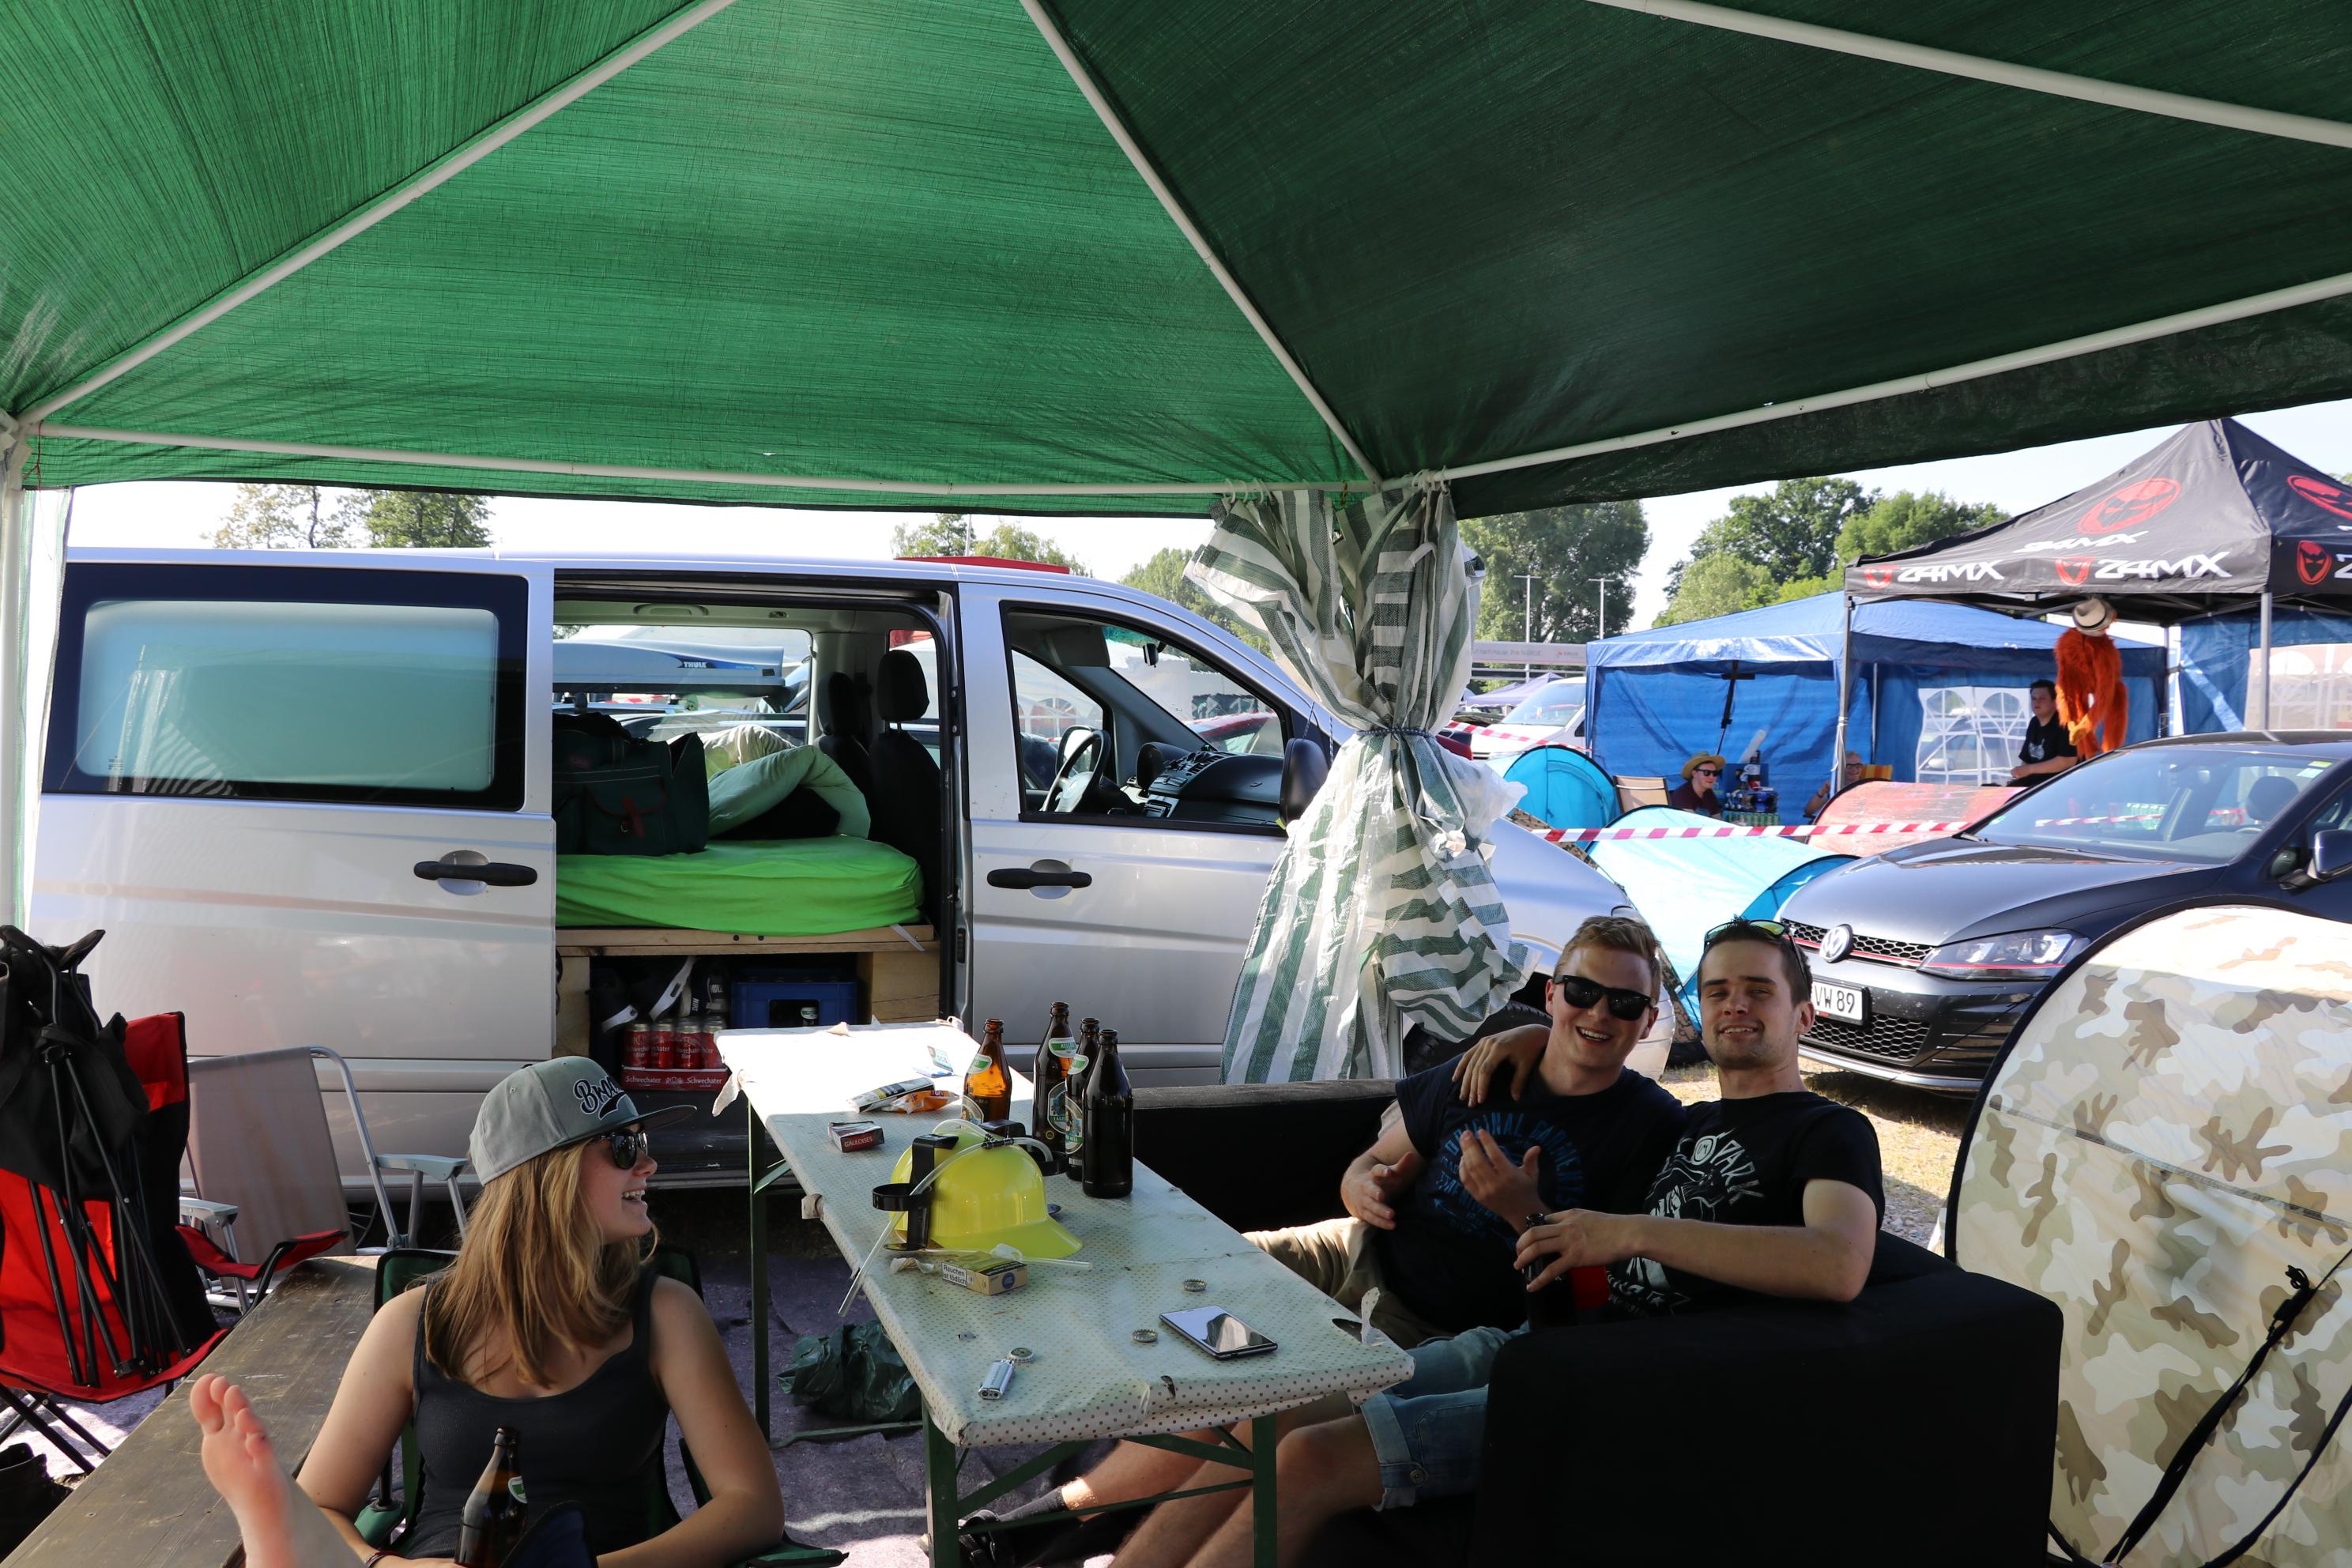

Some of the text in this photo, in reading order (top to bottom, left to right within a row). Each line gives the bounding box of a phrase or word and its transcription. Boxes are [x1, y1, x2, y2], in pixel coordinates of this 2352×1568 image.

[1897, 560, 2005, 582] Z4MX
[2094, 551, 2233, 579] Z4MX
[1814, 985, 1856, 1014] VW 89
[626, 1075, 662, 1084] Schwechater
[686, 1076, 723, 1085] Schwechater
[844, 1136, 873, 1148] GAULOISES
[943, 1264, 965, 1277] Rauchen
